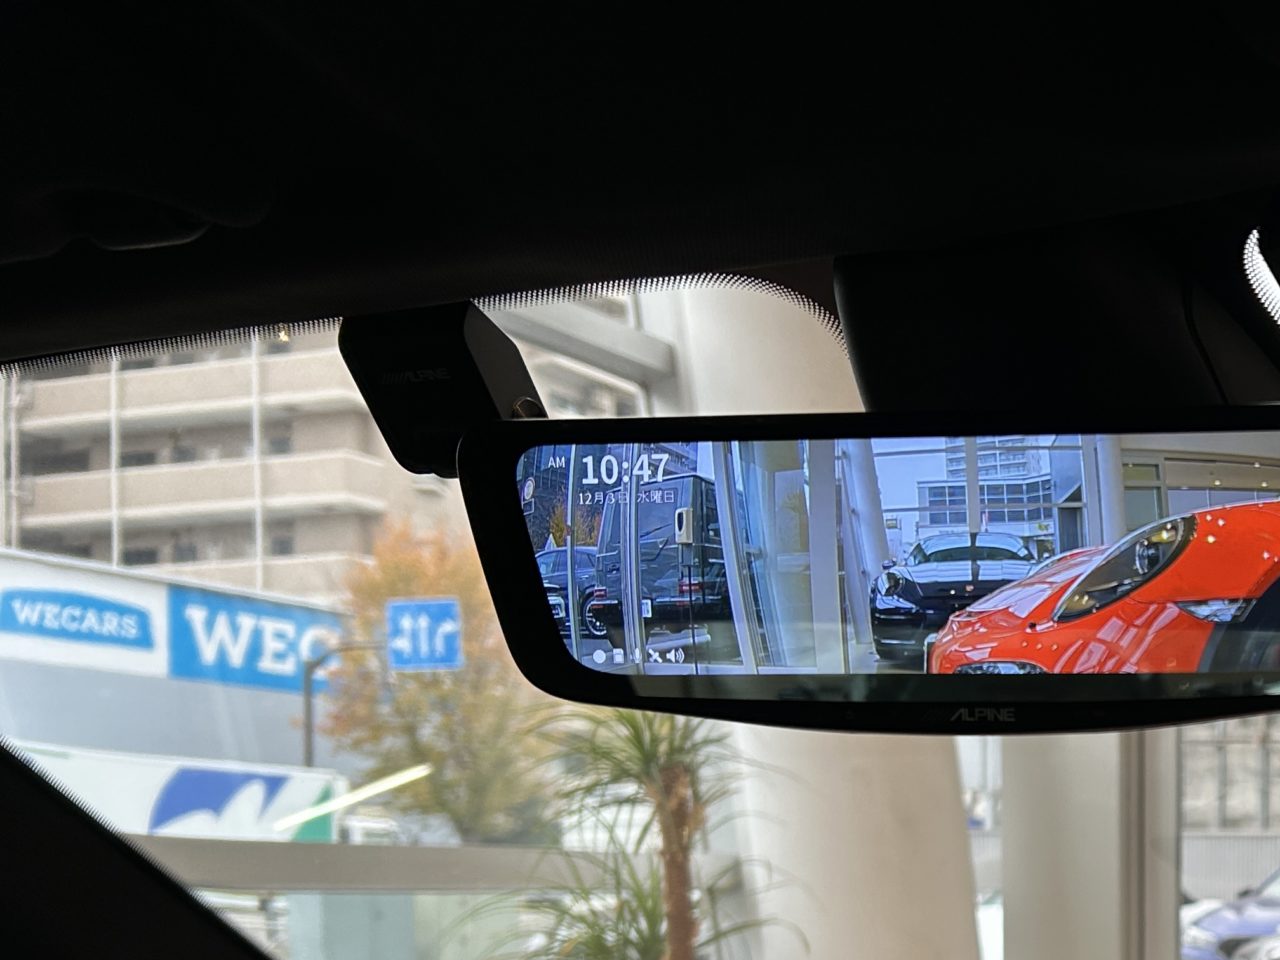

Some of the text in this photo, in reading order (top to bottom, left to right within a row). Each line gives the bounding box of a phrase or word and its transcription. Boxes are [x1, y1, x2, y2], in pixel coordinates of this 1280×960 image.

[547, 453, 669, 485] AM 10:47
[579, 490, 675, 505] 12月3日 水曜日
[12, 598, 140, 640] WECARS
[948, 707, 1016, 722] ALPINE
